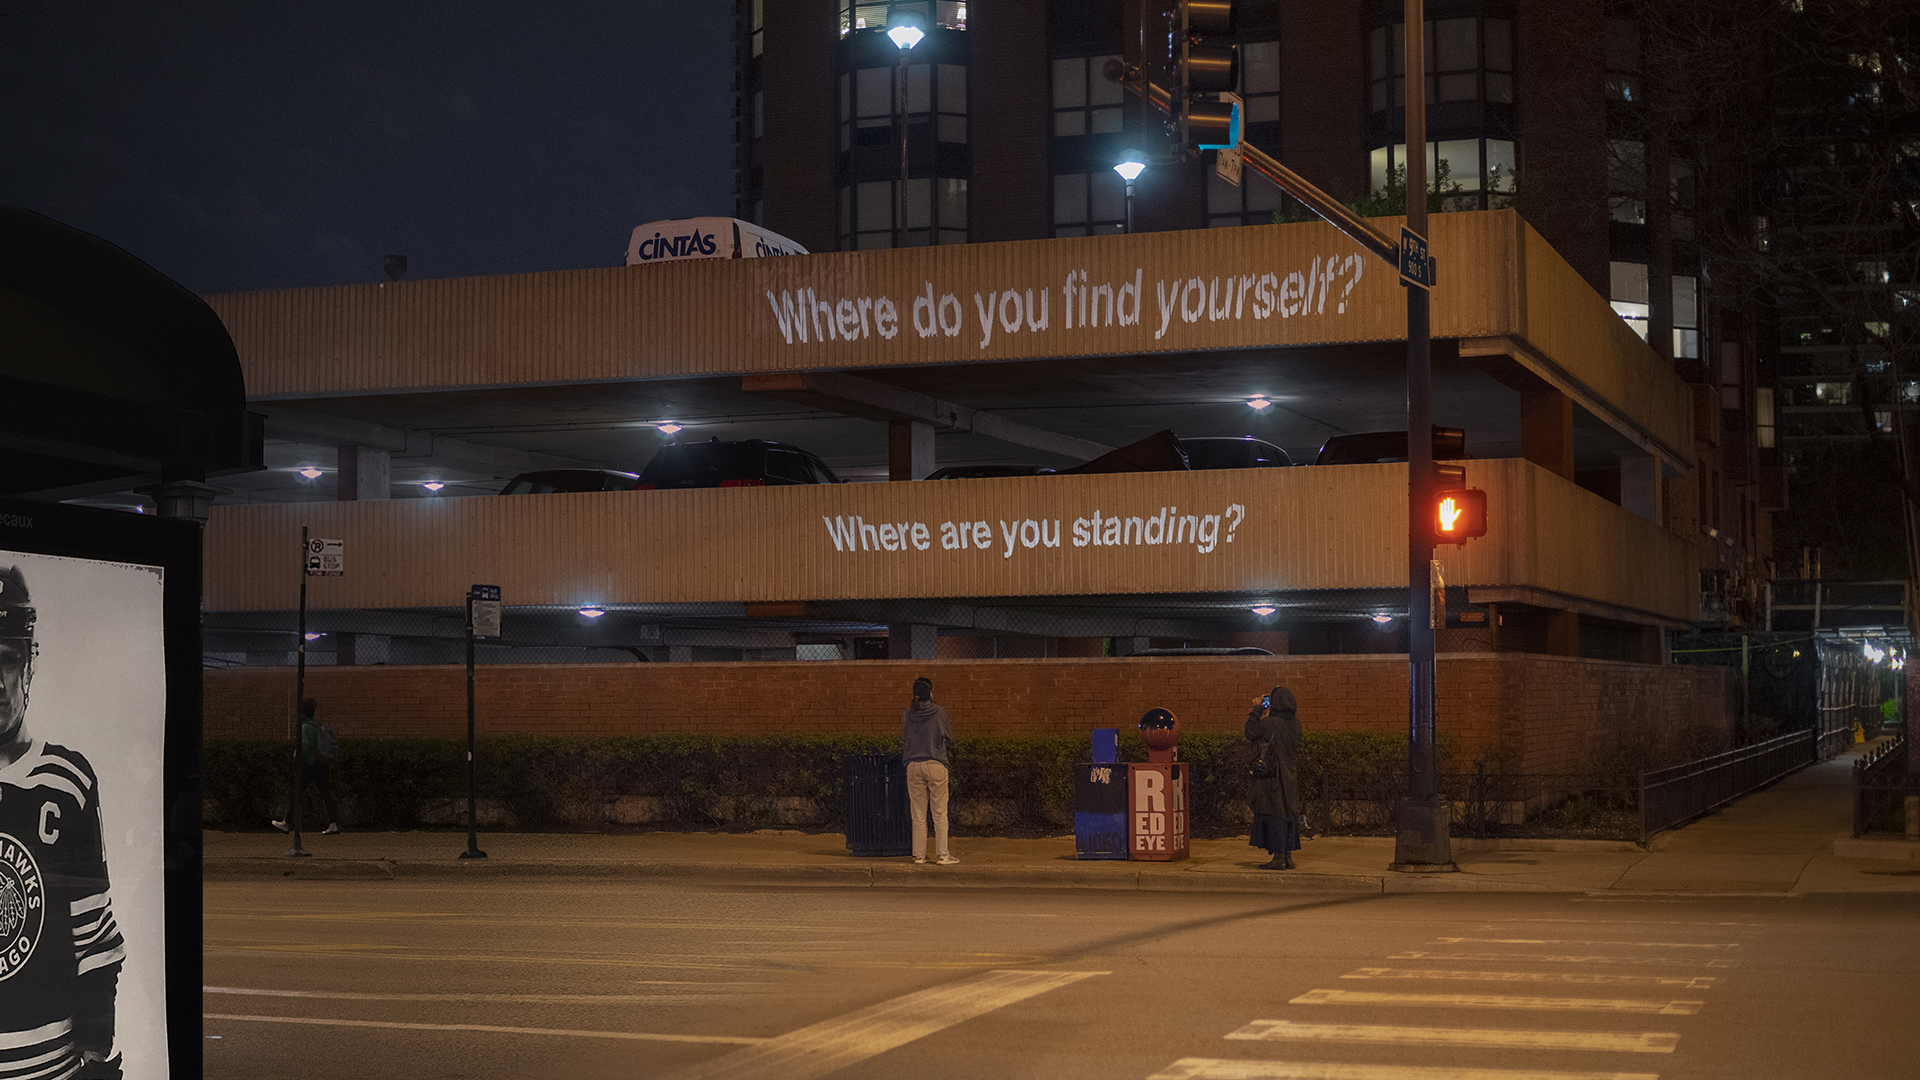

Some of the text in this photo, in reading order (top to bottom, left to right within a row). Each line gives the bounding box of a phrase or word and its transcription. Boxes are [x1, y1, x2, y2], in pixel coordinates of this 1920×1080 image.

[766, 253, 1364, 349] Where do you find yourself?
[823, 503, 1246, 559] Where are you standing?
[1135, 769, 1167, 812] R
[37, 801, 62, 845] C
[1136, 812, 1166, 835] ED
[1173, 812, 1184, 835] ED
[1136, 835, 1166, 851] EYE
[1173, 834, 1185, 850] EYE
